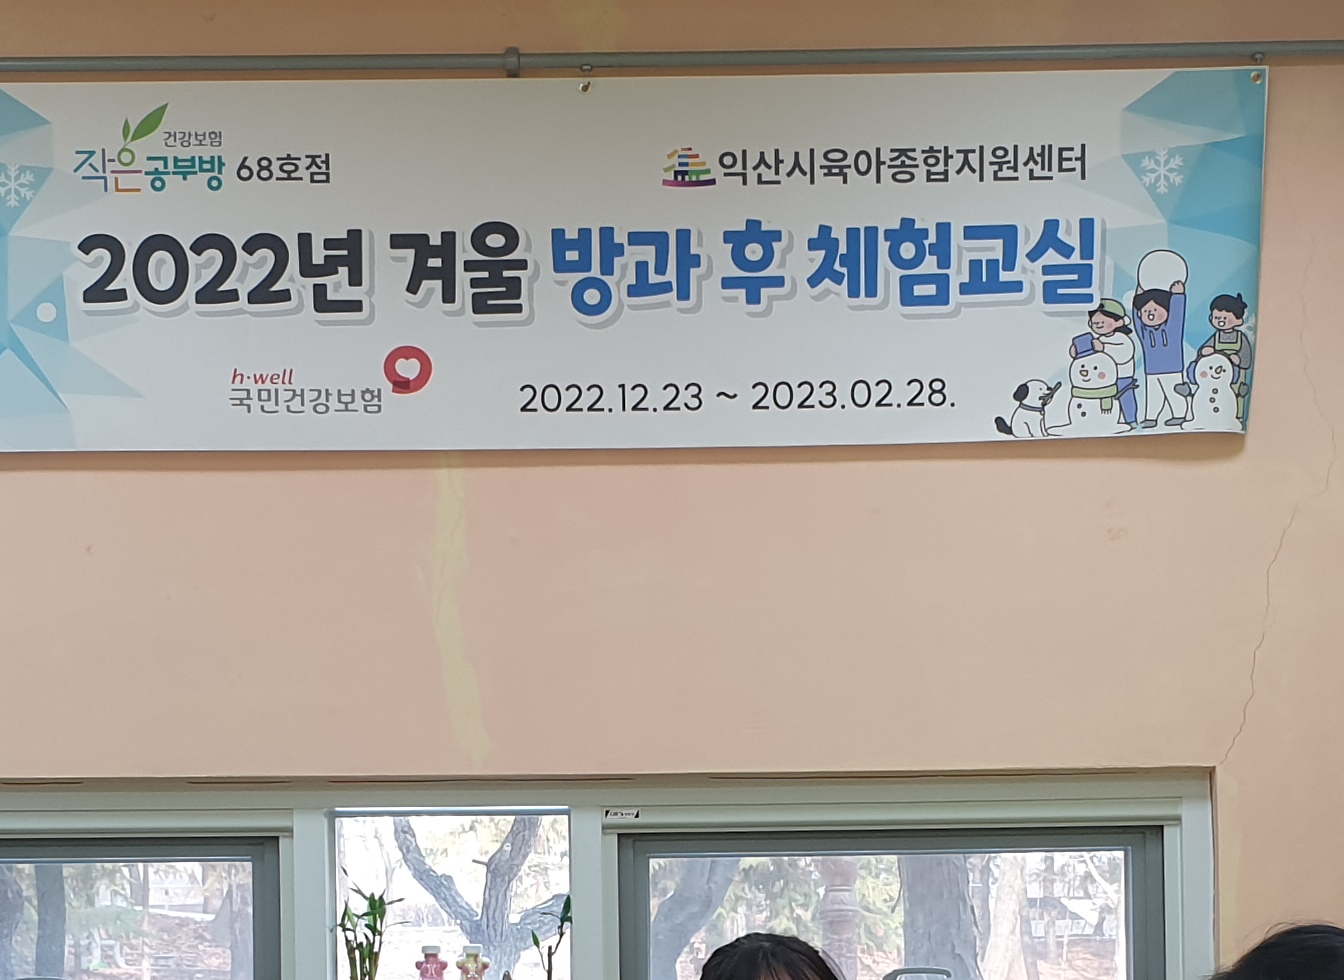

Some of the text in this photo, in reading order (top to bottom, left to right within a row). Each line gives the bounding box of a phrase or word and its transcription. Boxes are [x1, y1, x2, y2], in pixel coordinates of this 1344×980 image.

[163, 131, 223, 148] 건강보험
[73, 148, 331, 192] 작은 공부방 68호점
[718, 143, 1087, 186] 익산시육아종합지원센터
[78, 217, 1096, 317] 2022년 겨울 방과 후 체험교실
[229, 388, 383, 414] 국민건강보험
[519, 383, 704, 413] 2022.12.23
[751, 378, 956, 410] 2023.02.28.
